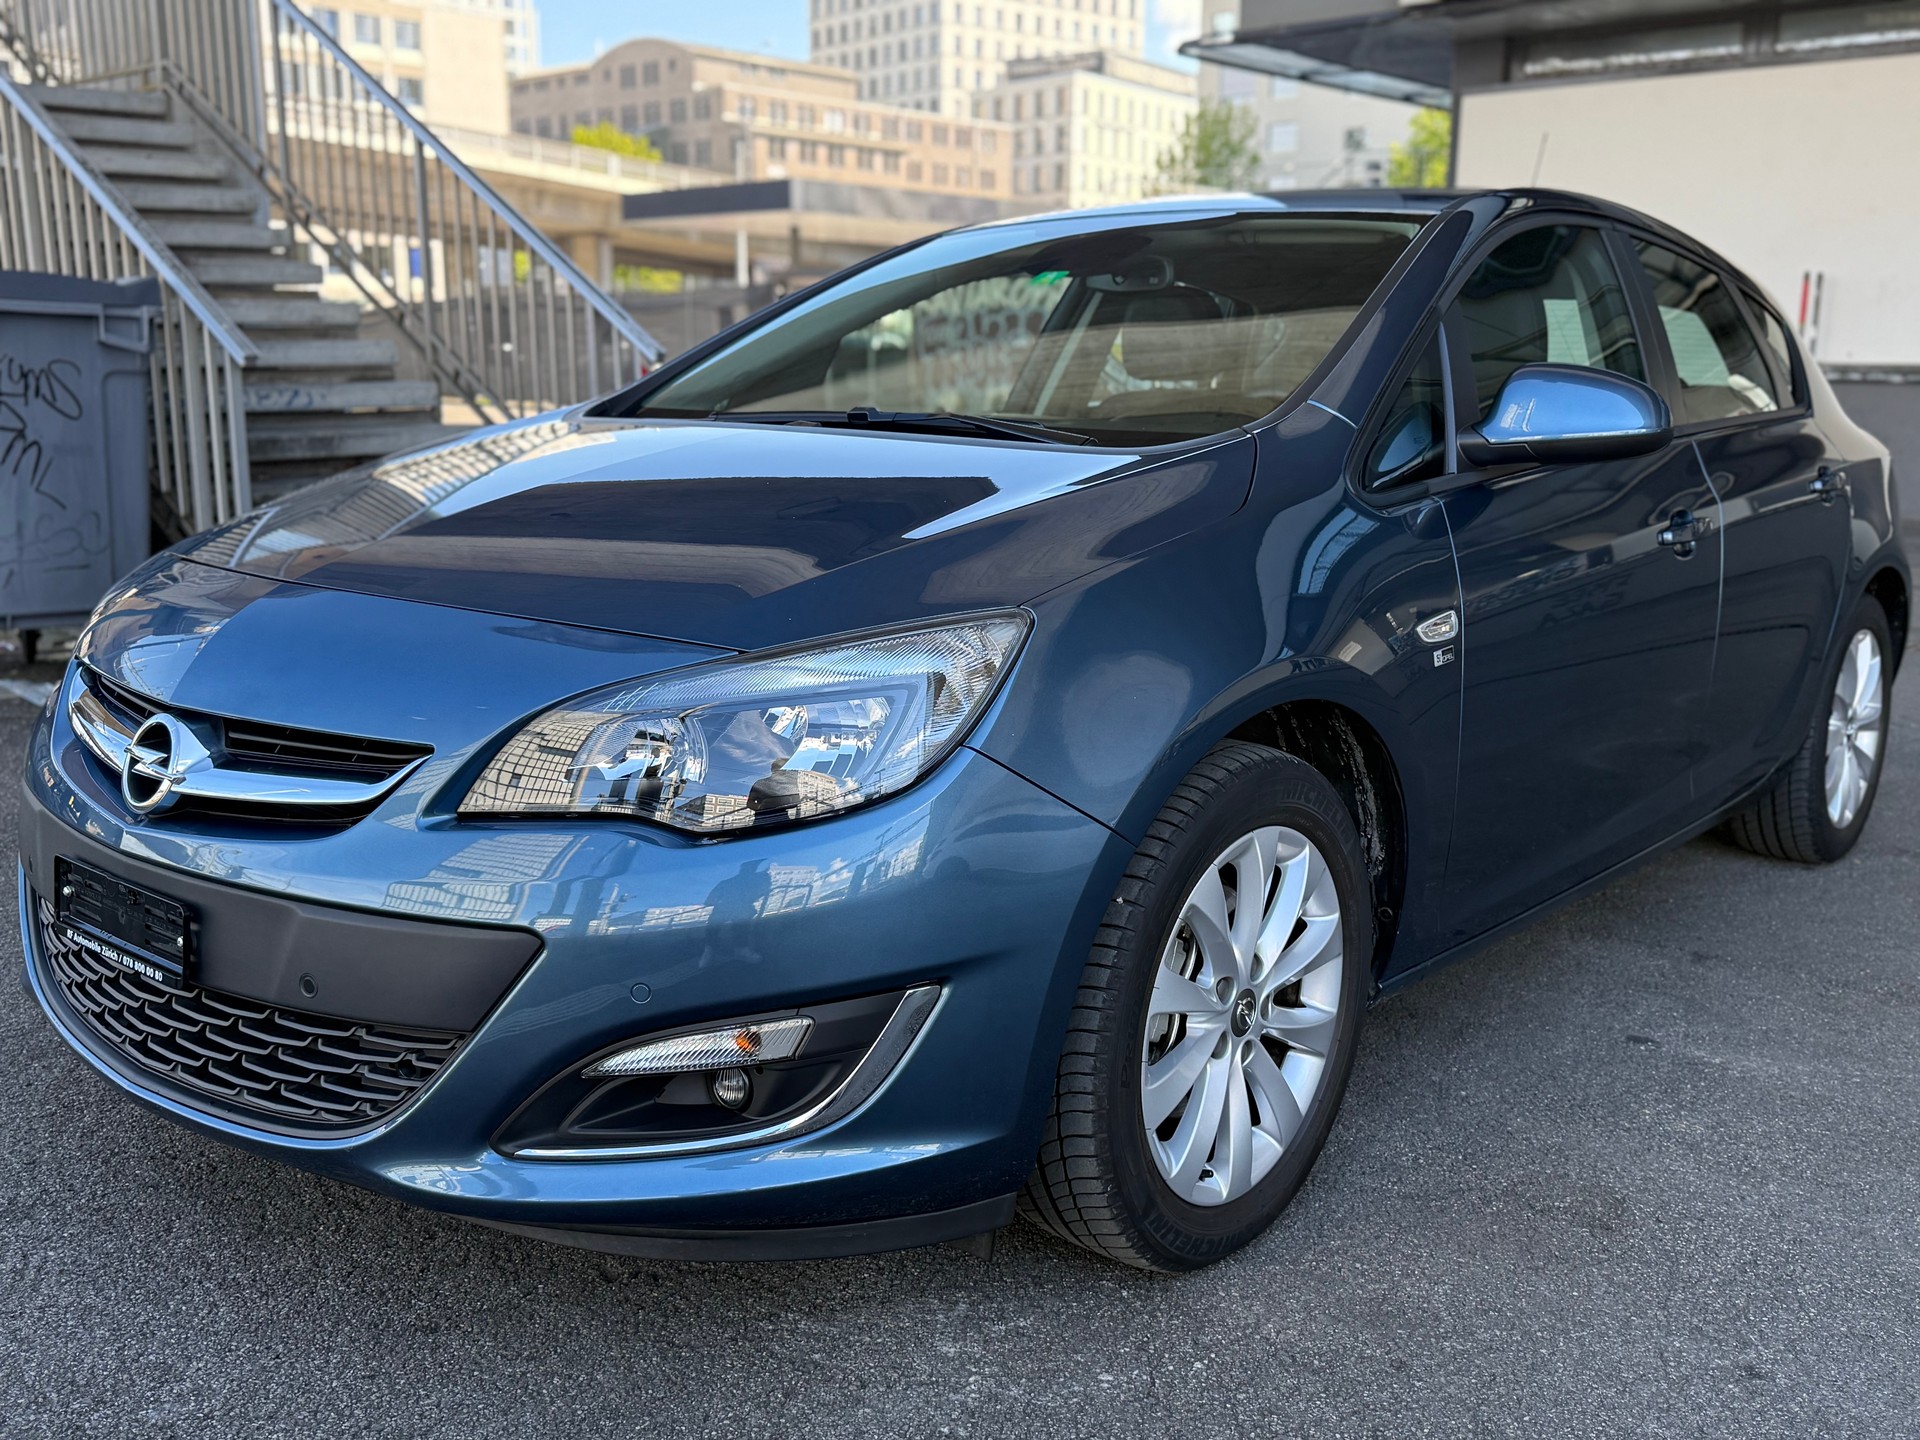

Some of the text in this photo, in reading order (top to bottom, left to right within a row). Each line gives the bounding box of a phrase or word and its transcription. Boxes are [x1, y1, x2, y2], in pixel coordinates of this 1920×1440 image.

[1280, 780, 1355, 847] MICHELIN
[73, 932, 101, 953] Automobile
[101, 945, 118, 961] Zürich
[122, 956, 134, 969] 078
[1145, 1210, 1240, 1257] MICHELIN
